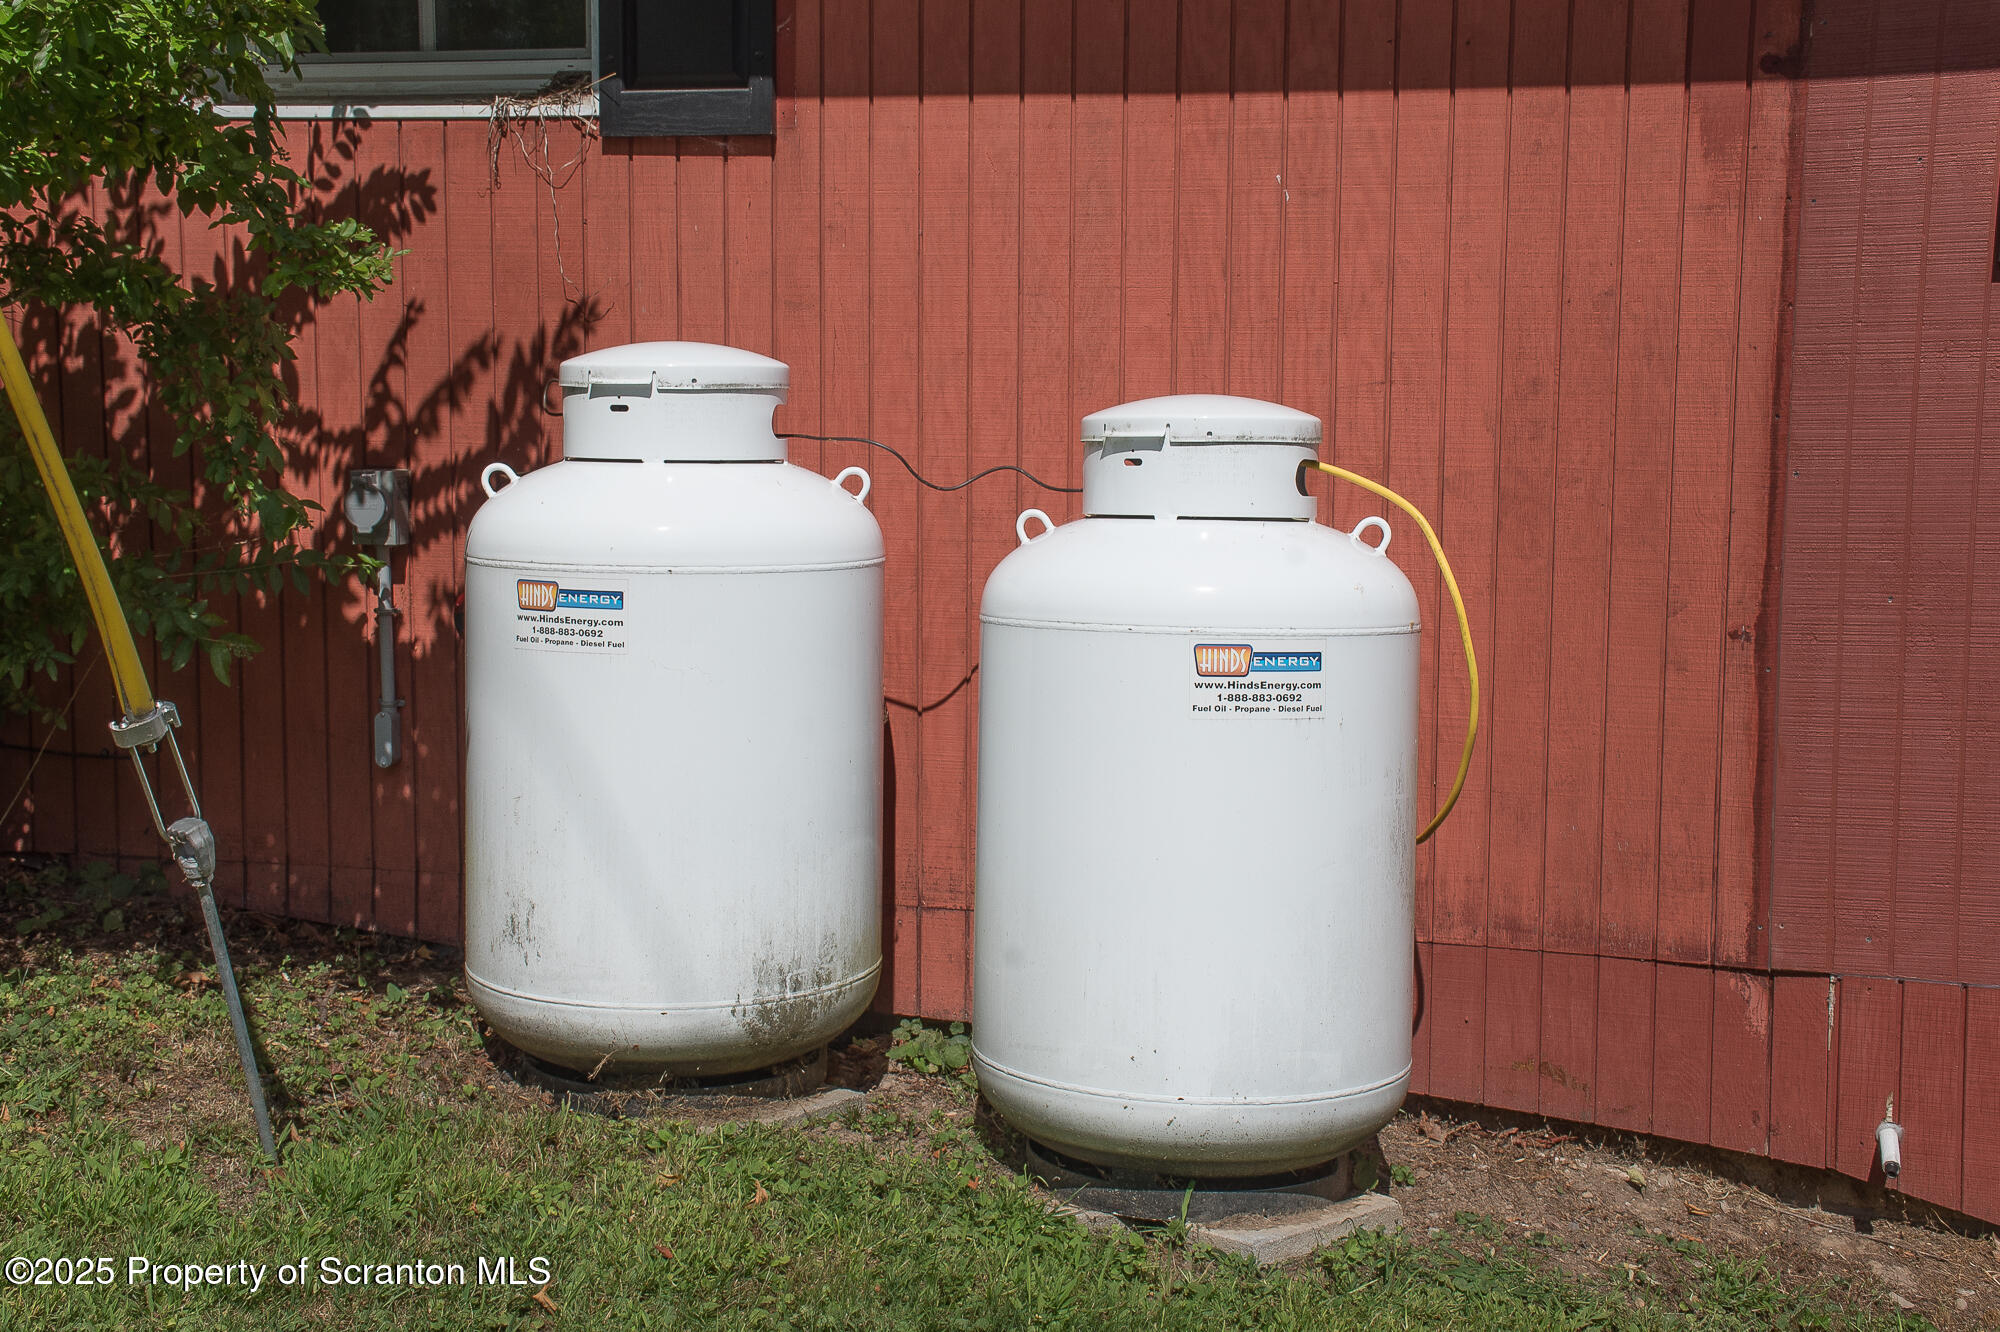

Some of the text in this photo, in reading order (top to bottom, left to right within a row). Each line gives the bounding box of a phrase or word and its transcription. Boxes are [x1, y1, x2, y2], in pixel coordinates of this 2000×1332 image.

[520, 583, 621, 608] HINDS ENERGY
[516, 614, 624, 627] www.HindsEnergy.com
[532, 625, 604, 638] 1-888-883-0692
[515, 635, 529, 643] Fuel
[530, 636, 540, 644] Oil
[544, 637, 574, 646] Propane
[580, 639, 605, 648] Diesel
[607, 640, 625, 648] Fuel
[1199, 647, 1319, 673] HINDS ENERGY
[1193, 680, 1322, 691] www.HindsEnergy.com
[1216, 693, 1303, 702] 1-888-883-0692
[1192, 704, 1212, 712] Fuel
[1213, 704, 1227, 713] Oil
[1234, 705, 1271, 714] Propane
[1278, 704, 1304, 713] Diesel
[1305, 704, 1323, 712] Fuel
